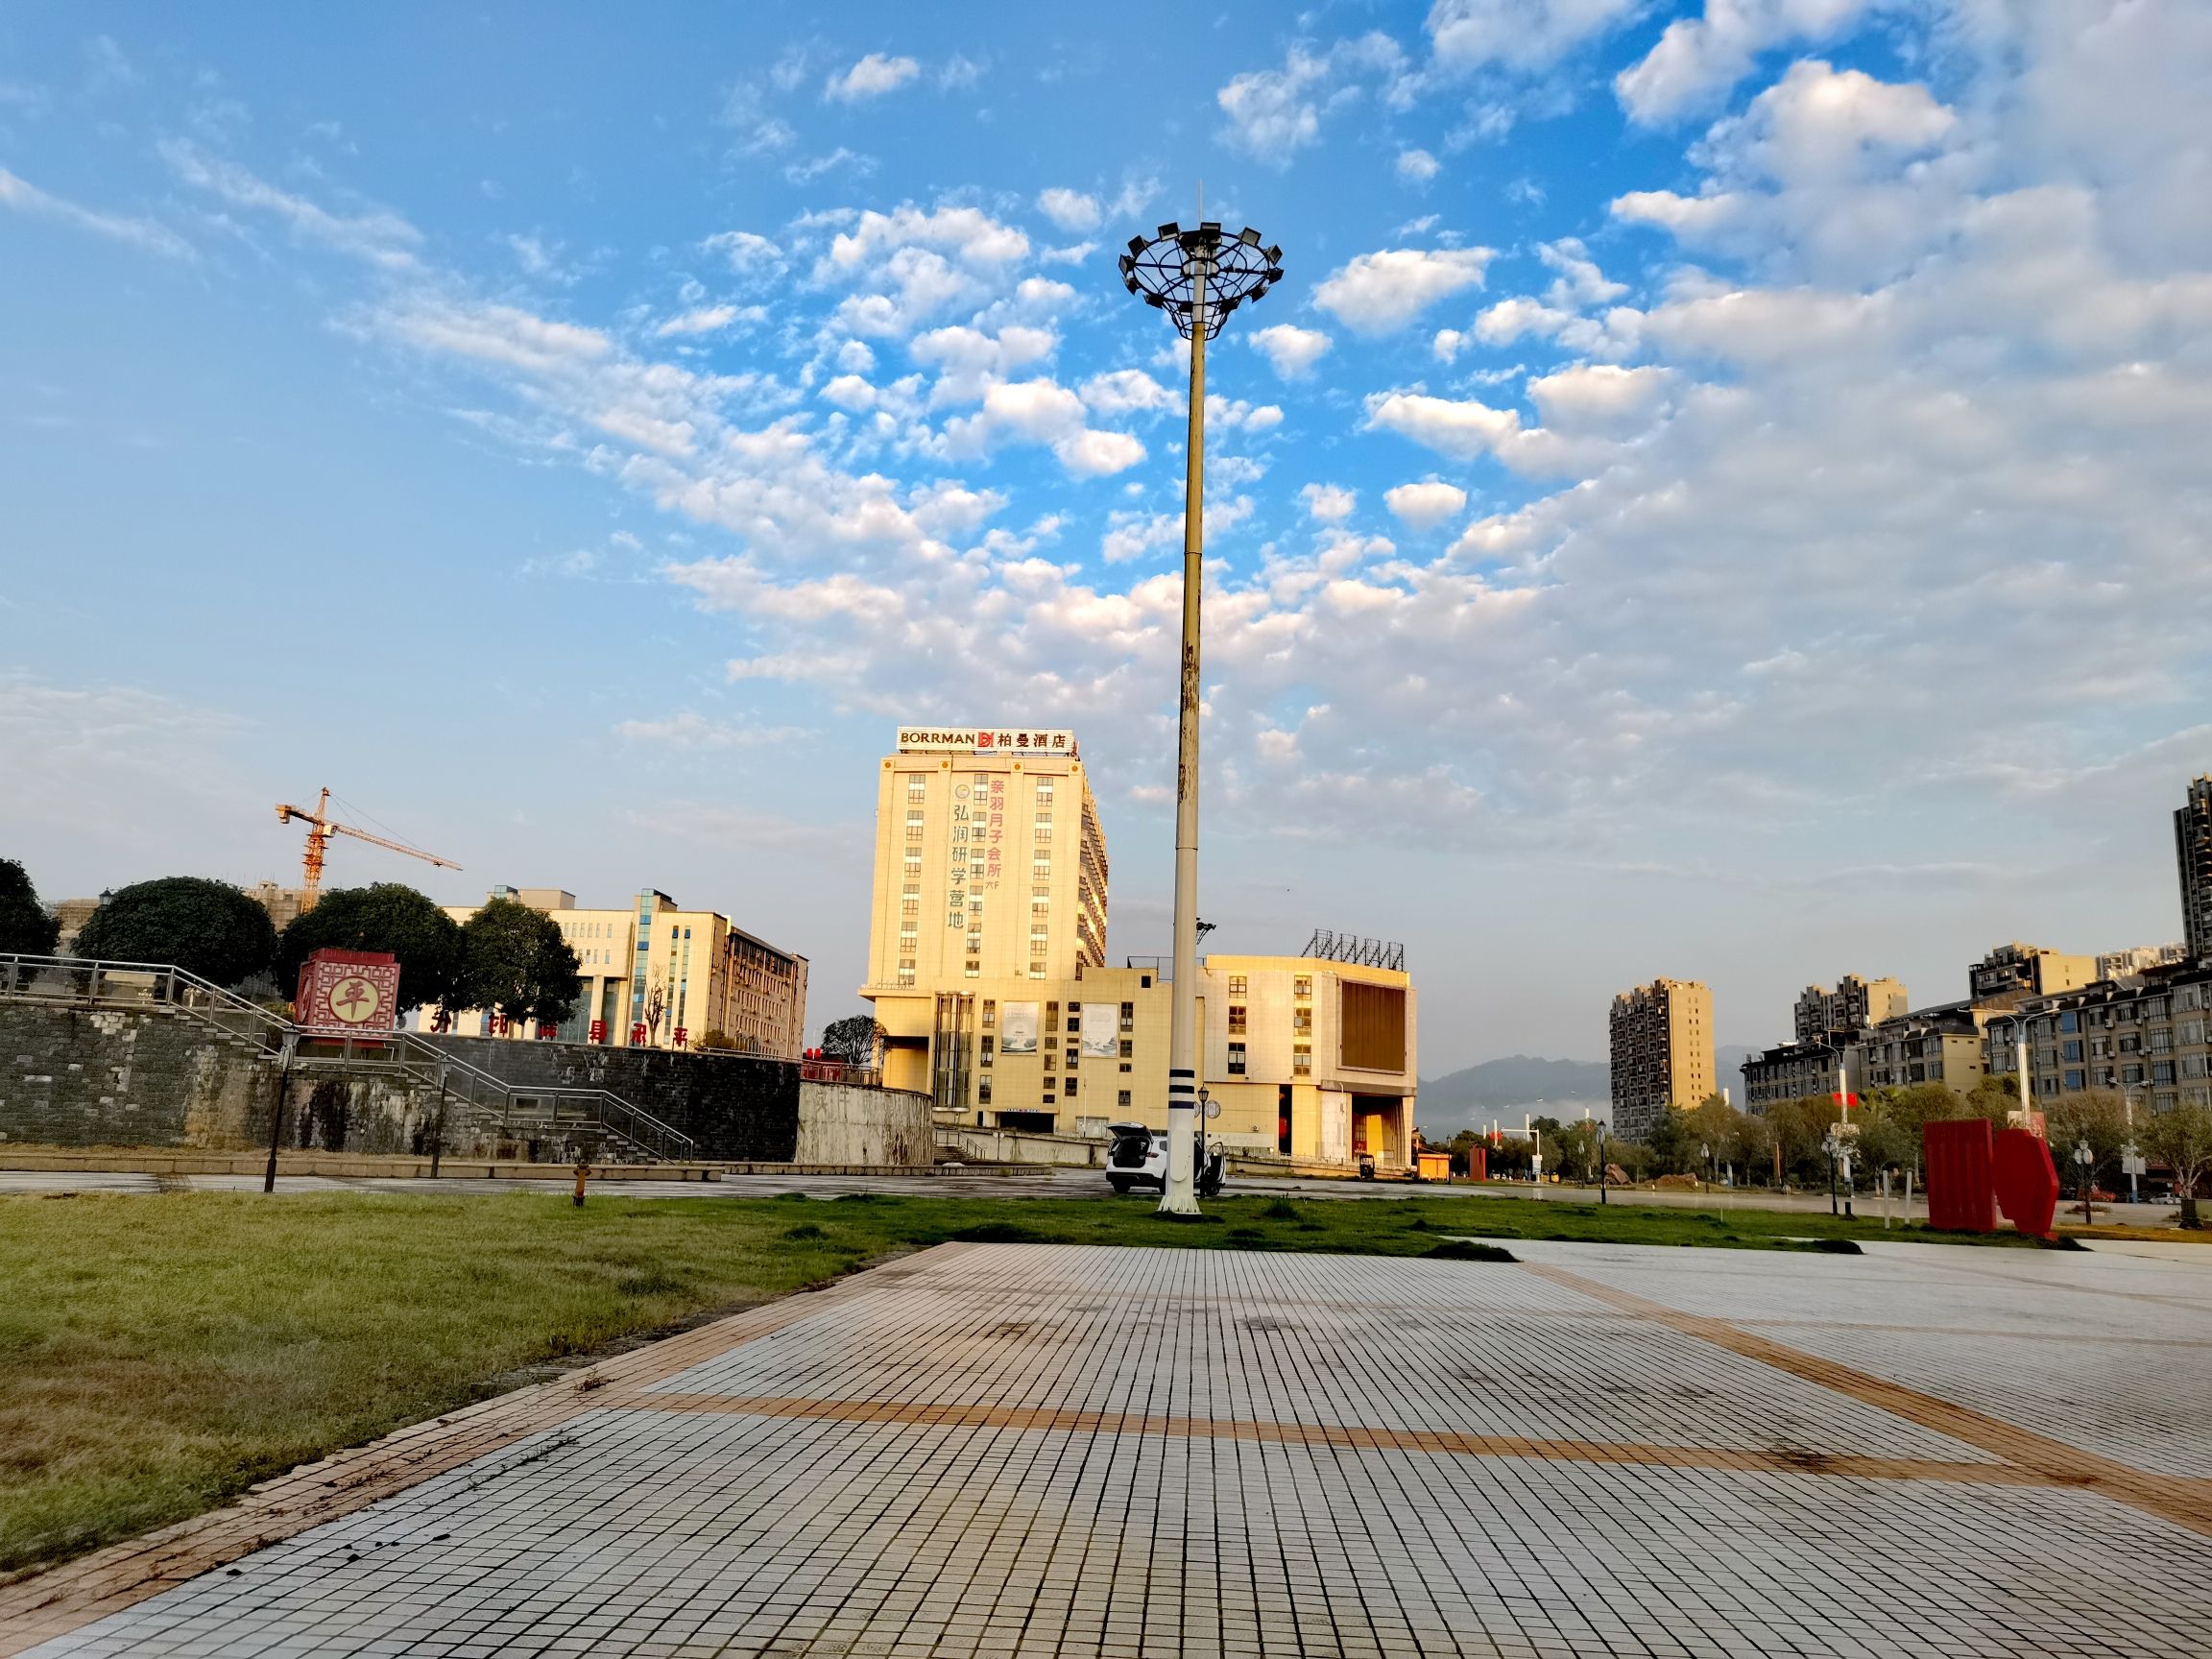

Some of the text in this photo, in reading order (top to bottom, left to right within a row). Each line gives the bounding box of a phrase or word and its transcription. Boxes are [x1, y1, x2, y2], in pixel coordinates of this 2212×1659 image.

[901, 733, 975, 744] BORRMAN
[998, 733, 1067, 747] 柏曼酒店
[987, 780, 1004, 878] 亲羽月子会所
[948, 805, 969, 928] 弘润研学营地
[336, 980, 370, 1019] 平
